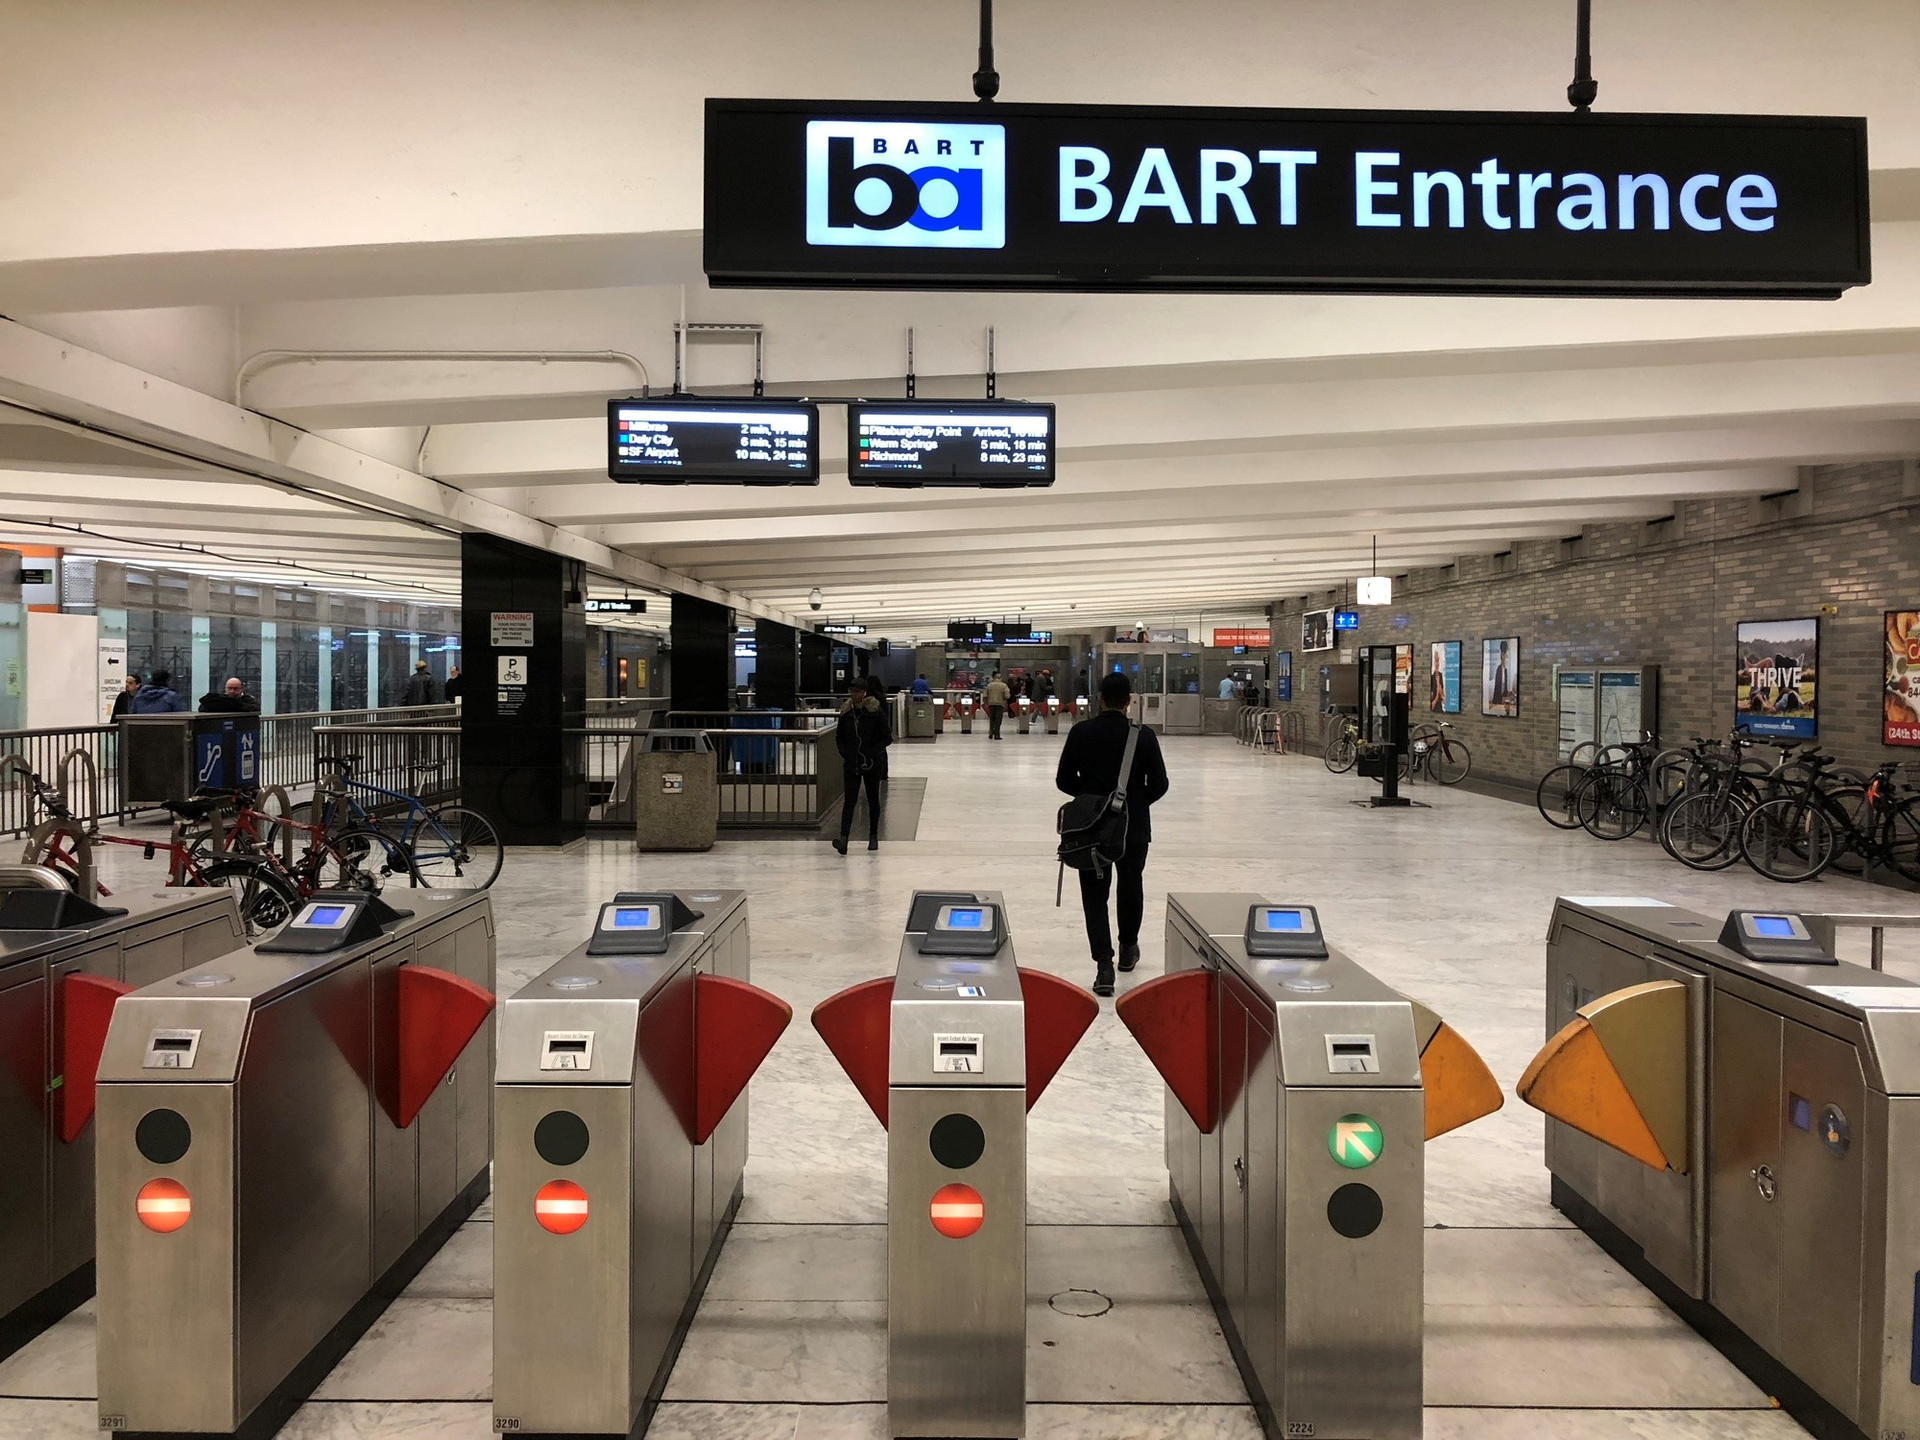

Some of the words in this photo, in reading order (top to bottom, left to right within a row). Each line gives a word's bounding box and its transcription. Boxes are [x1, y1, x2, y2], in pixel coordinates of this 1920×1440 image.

[873, 138, 984, 156] BART
[1059, 146, 1317, 226] BART
[1354, 151, 1778, 232] Entrance
[741, 424, 749, 434] 2
[869, 426, 934, 438] Pittsburg/Bay
[936, 426, 962, 437] Point
[629, 434, 652, 446] Daly
[653, 434, 674, 446] City
[740, 437, 749, 447] 6
[774, 438, 787, 448] 15
[788, 438, 807, 448] min
[869, 439, 898, 449] Warm
[900, 439, 938, 451] Springs
[980, 440, 987, 450] 5
[1014, 440, 1026, 450] 18
[1028, 441, 1046, 450] min
[629, 447, 643, 456] SF
[645, 447, 679, 459] Airport
[736, 450, 748, 459] 10
[773, 450, 787, 460] 24
[788, 451, 807, 461] min
[870, 451, 918, 461] Richmond
[980, 453, 988, 462] 8
[1013, 453, 1026, 463] 23
[1028, 454, 1046, 463] min
[509, 659, 517, 669] P
[1749, 667, 1802, 688] THRIVE
[101, 1418, 123, 1427] 3291
[495, 1418, 519, 1428] 3290
[1289, 1423, 1313, 1433] 2224
